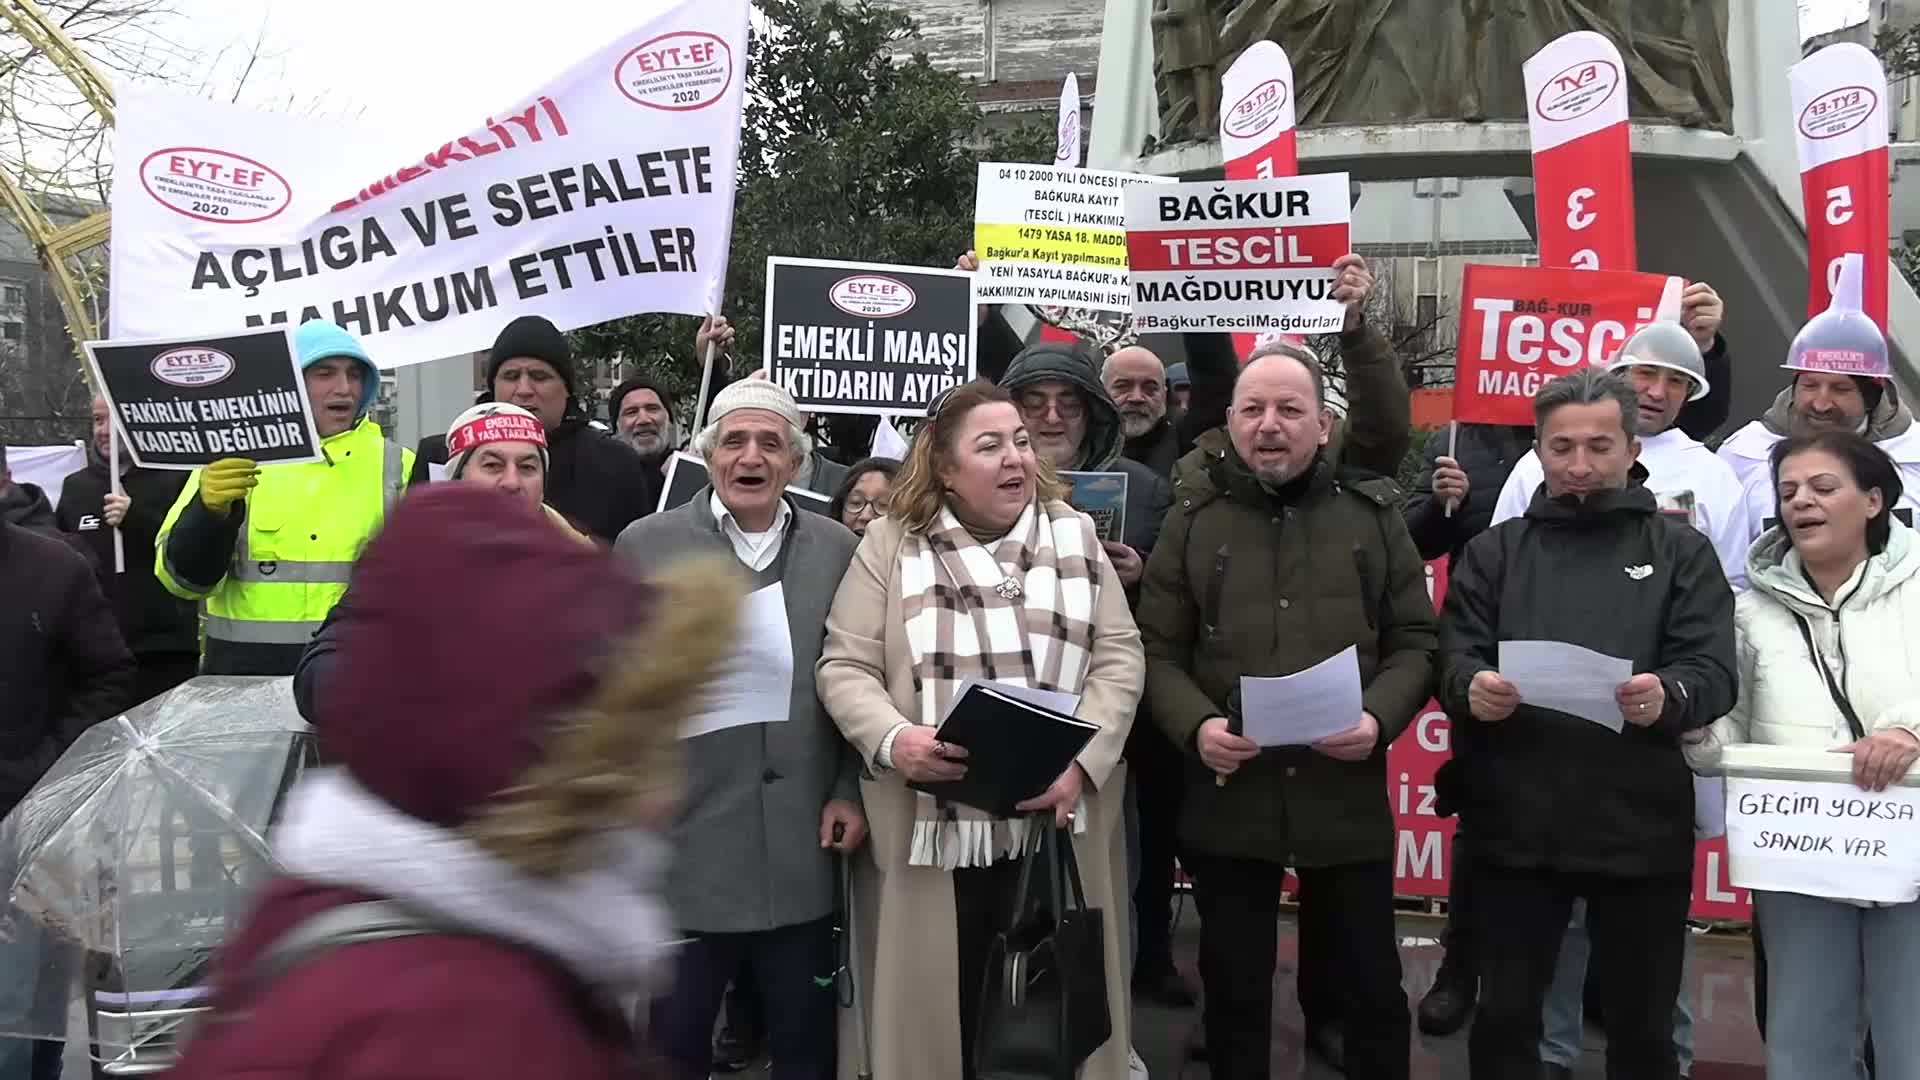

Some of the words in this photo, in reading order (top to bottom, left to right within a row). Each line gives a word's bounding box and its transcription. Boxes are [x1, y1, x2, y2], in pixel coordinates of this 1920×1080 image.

[636, 41, 714, 72] EYT-EF
[672, 89, 700, 103] 2020
[170, 155, 265, 187] EYT-EF
[999, 169, 1010, 179] 04
[1015, 169, 1026, 180] 10
[1029, 170, 1053, 181] 2000
[1056, 172, 1076, 184] YILI
[1079, 172, 1118, 188] ÖNCESİ
[192, 201, 229, 216] 2020
[1034, 189, 1084, 203] BAĞKURA
[1088, 195, 1119, 207] KAYIT
[1159, 186, 1310, 222] BAĞKUR
[191, 216, 397, 298] AÇLIGA
[401, 192, 479, 247] VE
[487, 146, 712, 227] SEFALETE
[1018, 228, 1041, 239] 1479
[1045, 230, 1071, 242] YASA
[1076, 232, 1090, 244] 18.
[1160, 228, 1313, 265] TESCİL
[987, 246, 1029, 260] Bağkur'a
[1032, 248, 1059, 262] Kayıt
[1061, 250, 1121, 267] yapılmasına
[246, 265, 498, 336] AHKUM
[509, 225, 697, 300] ETTİLER
[990, 266, 1014, 278] YENİ
[1017, 267, 1062, 280] YASAYLA
[1066, 269, 1118, 285] BAĞKUR'a
[1121, 275, 1130, 286] K
[848, 283, 899, 295] EYT-EF
[977, 286, 1035, 298] HAKKIMIZIN
[1038, 287, 1103, 303] YAPILMASINI
[1513, 299, 1592, 317] BAĞ-KUR
[1136, 314, 1340, 330] #BağkurTescilMağdurları
[778, 321, 874, 362] EMEKLİ
[884, 329, 966, 375] MAAŞI
[166, 353, 215, 367] EYT-EF
[776, 360, 894, 401] İKTİDARIN
[120, 396, 199, 424] FAKİRLİK
[200, 387, 300, 422] EMEKLİNİN
[131, 425, 204, 453] KADERİ
[205, 418, 304, 453] DEĞİLDİR
[1738, 792, 1819, 816] GEÇİM
[1753, 831, 1833, 853] SANDIK
[1844, 837, 1888, 857] VAR
